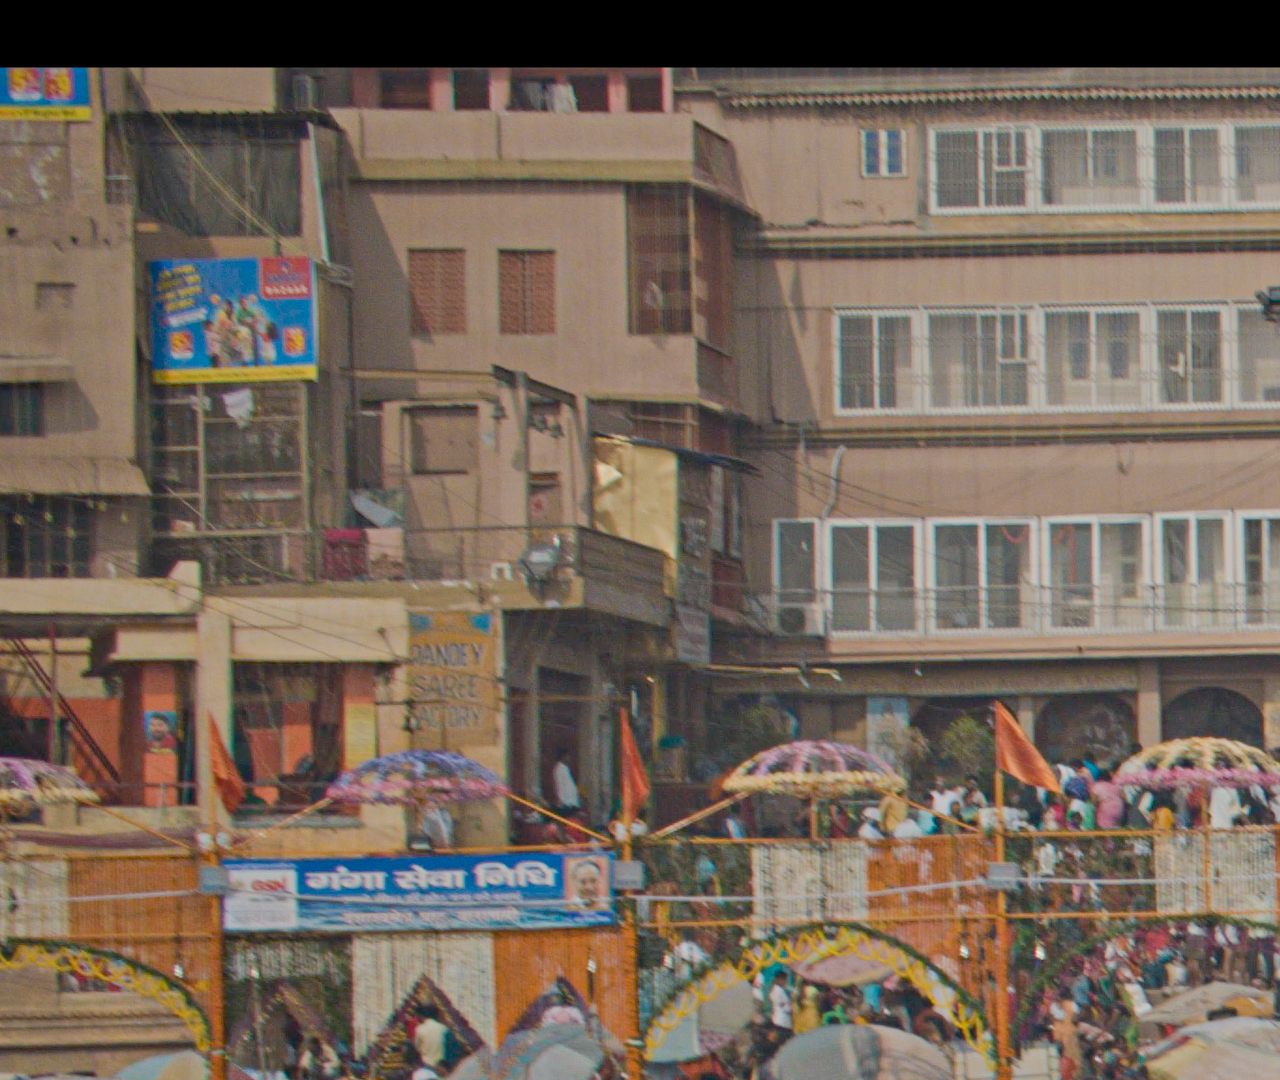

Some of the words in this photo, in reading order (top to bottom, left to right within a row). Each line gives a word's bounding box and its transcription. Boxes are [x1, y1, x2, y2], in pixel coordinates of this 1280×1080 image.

[410, 643, 484, 667] PANDEY
[412, 674, 480, 699] SAREE
[304, 866, 388, 890] गंगा
[393, 864, 468, 889] सेवा
[473, 860, 557, 888] निधि
